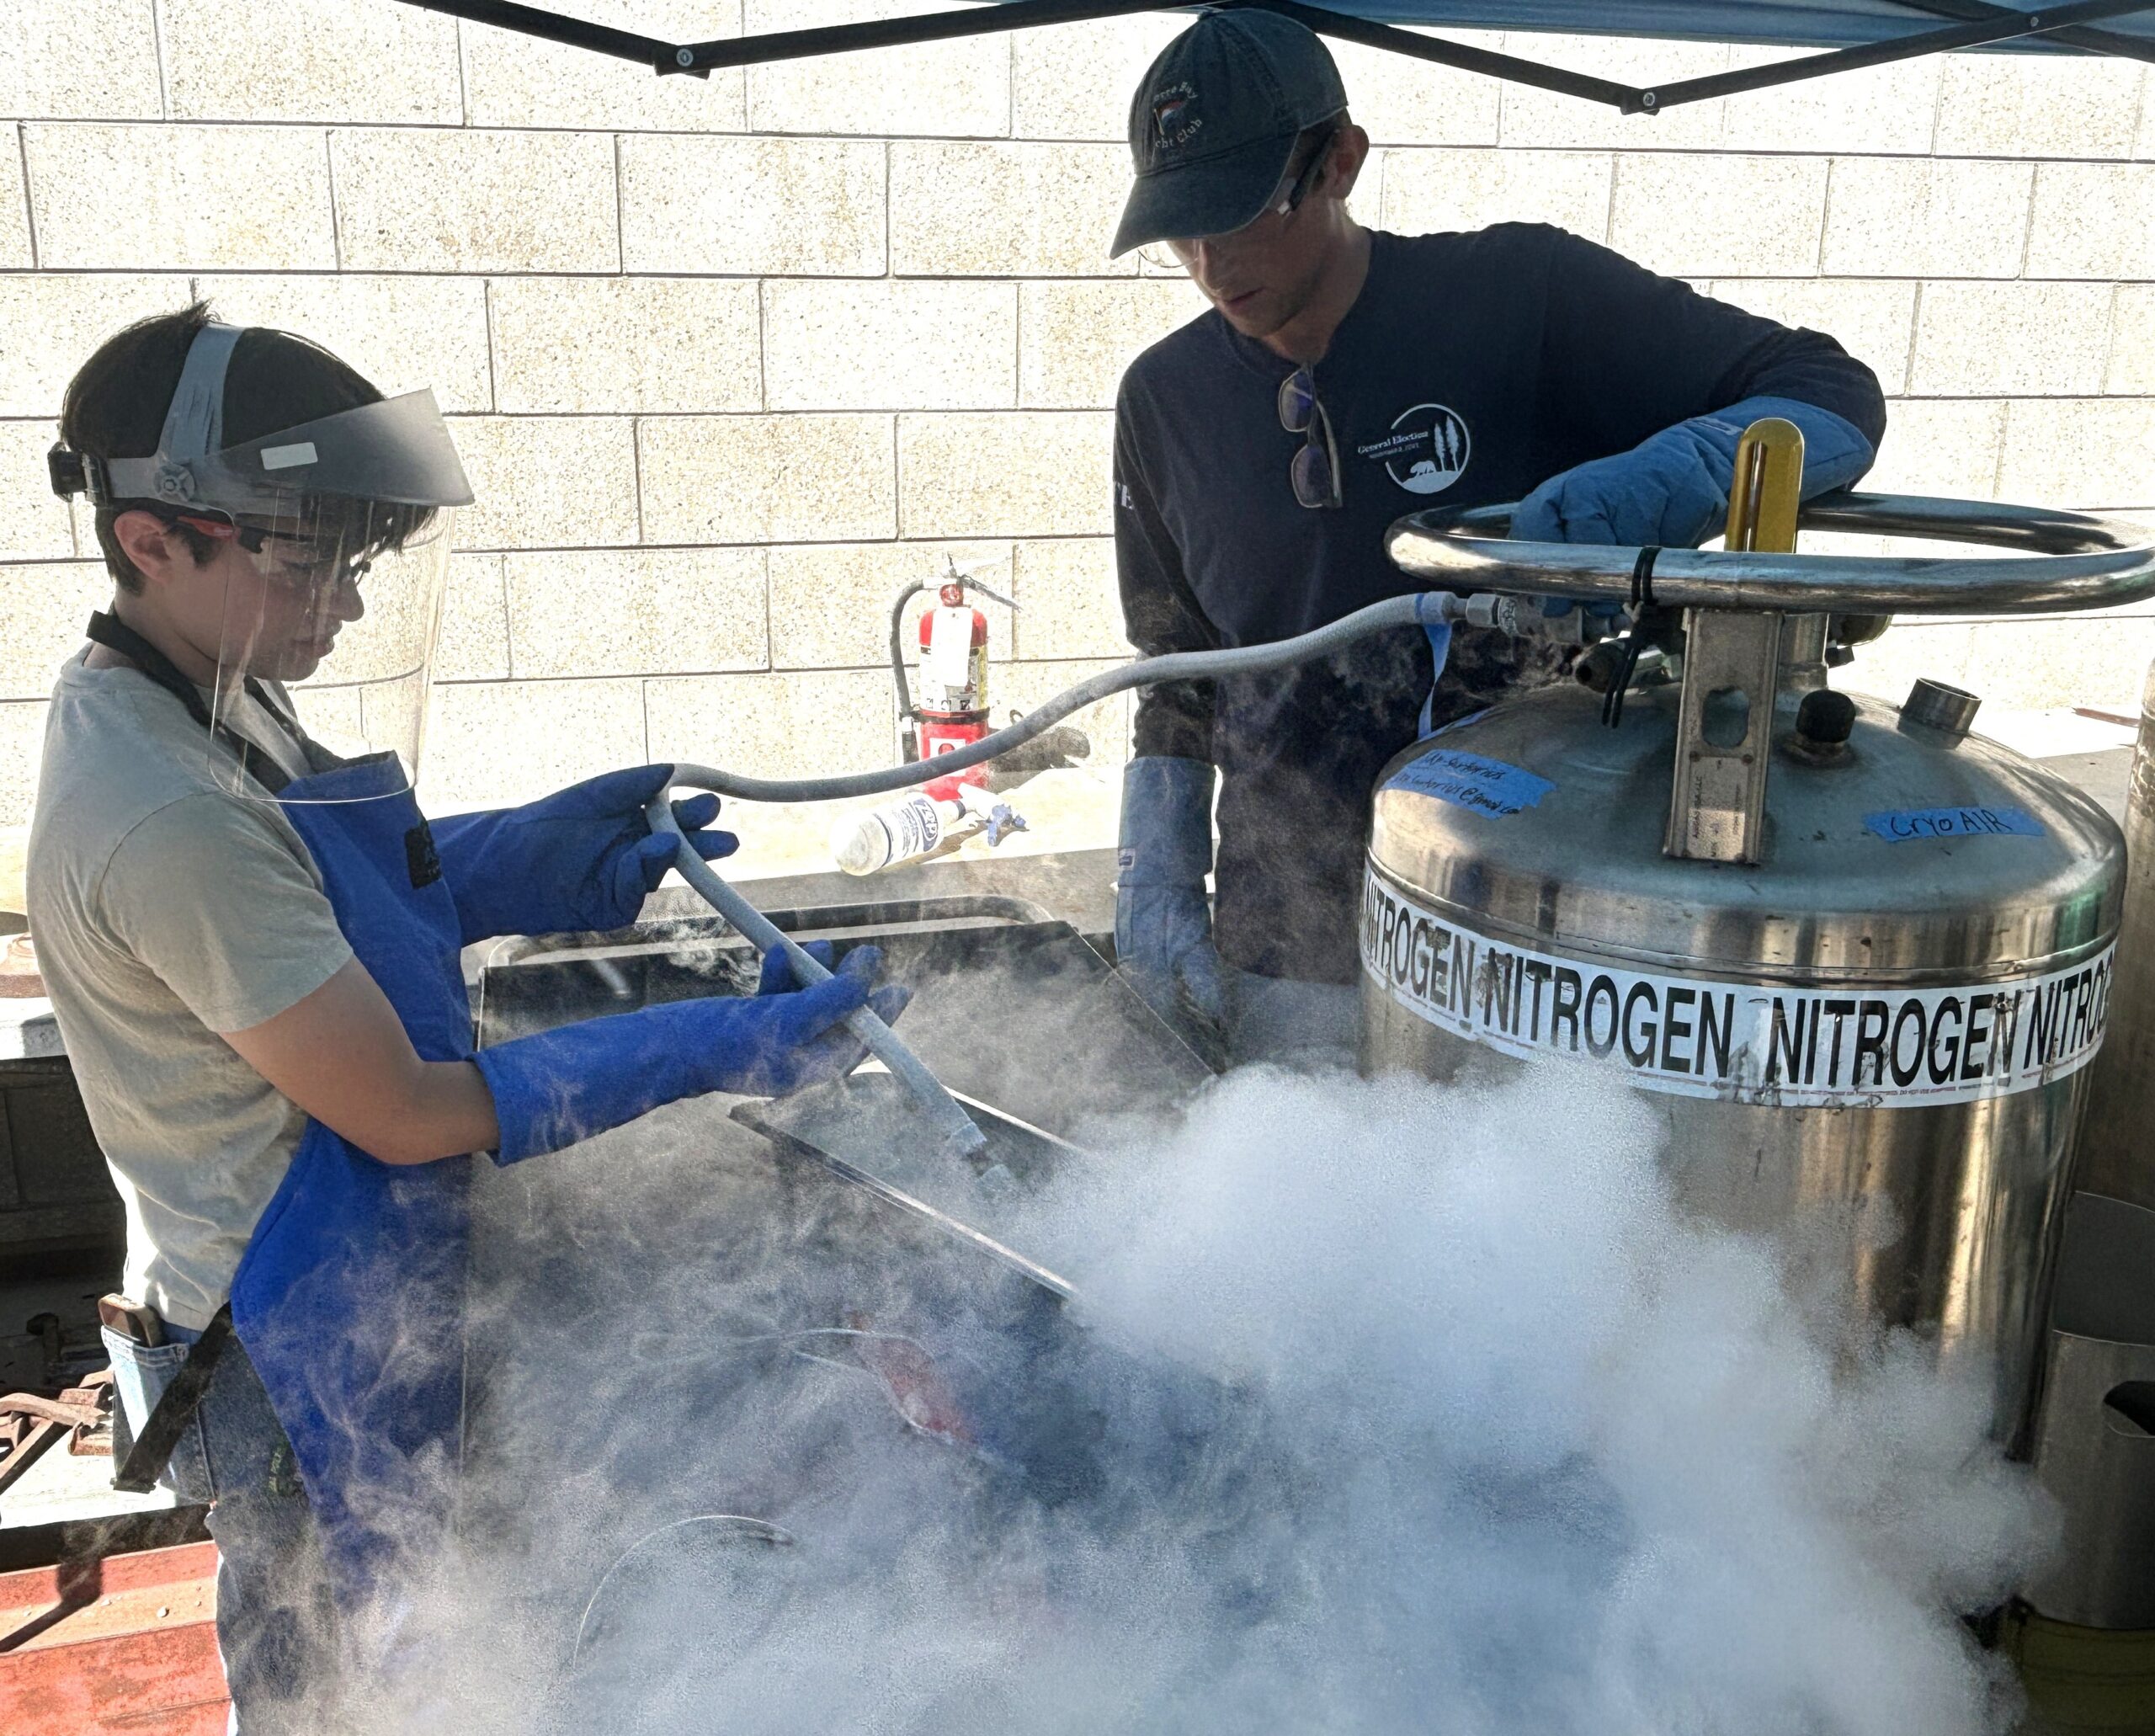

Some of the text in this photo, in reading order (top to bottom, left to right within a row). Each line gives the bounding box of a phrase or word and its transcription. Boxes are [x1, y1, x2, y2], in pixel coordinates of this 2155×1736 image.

[1960, 808, 2014, 834] AIR
[1365, 871, 1477, 1019] NITROGEN
[1482, 946, 1736, 1078] NITROGEN
[1767, 990, 2021, 1088] NITROGEN
